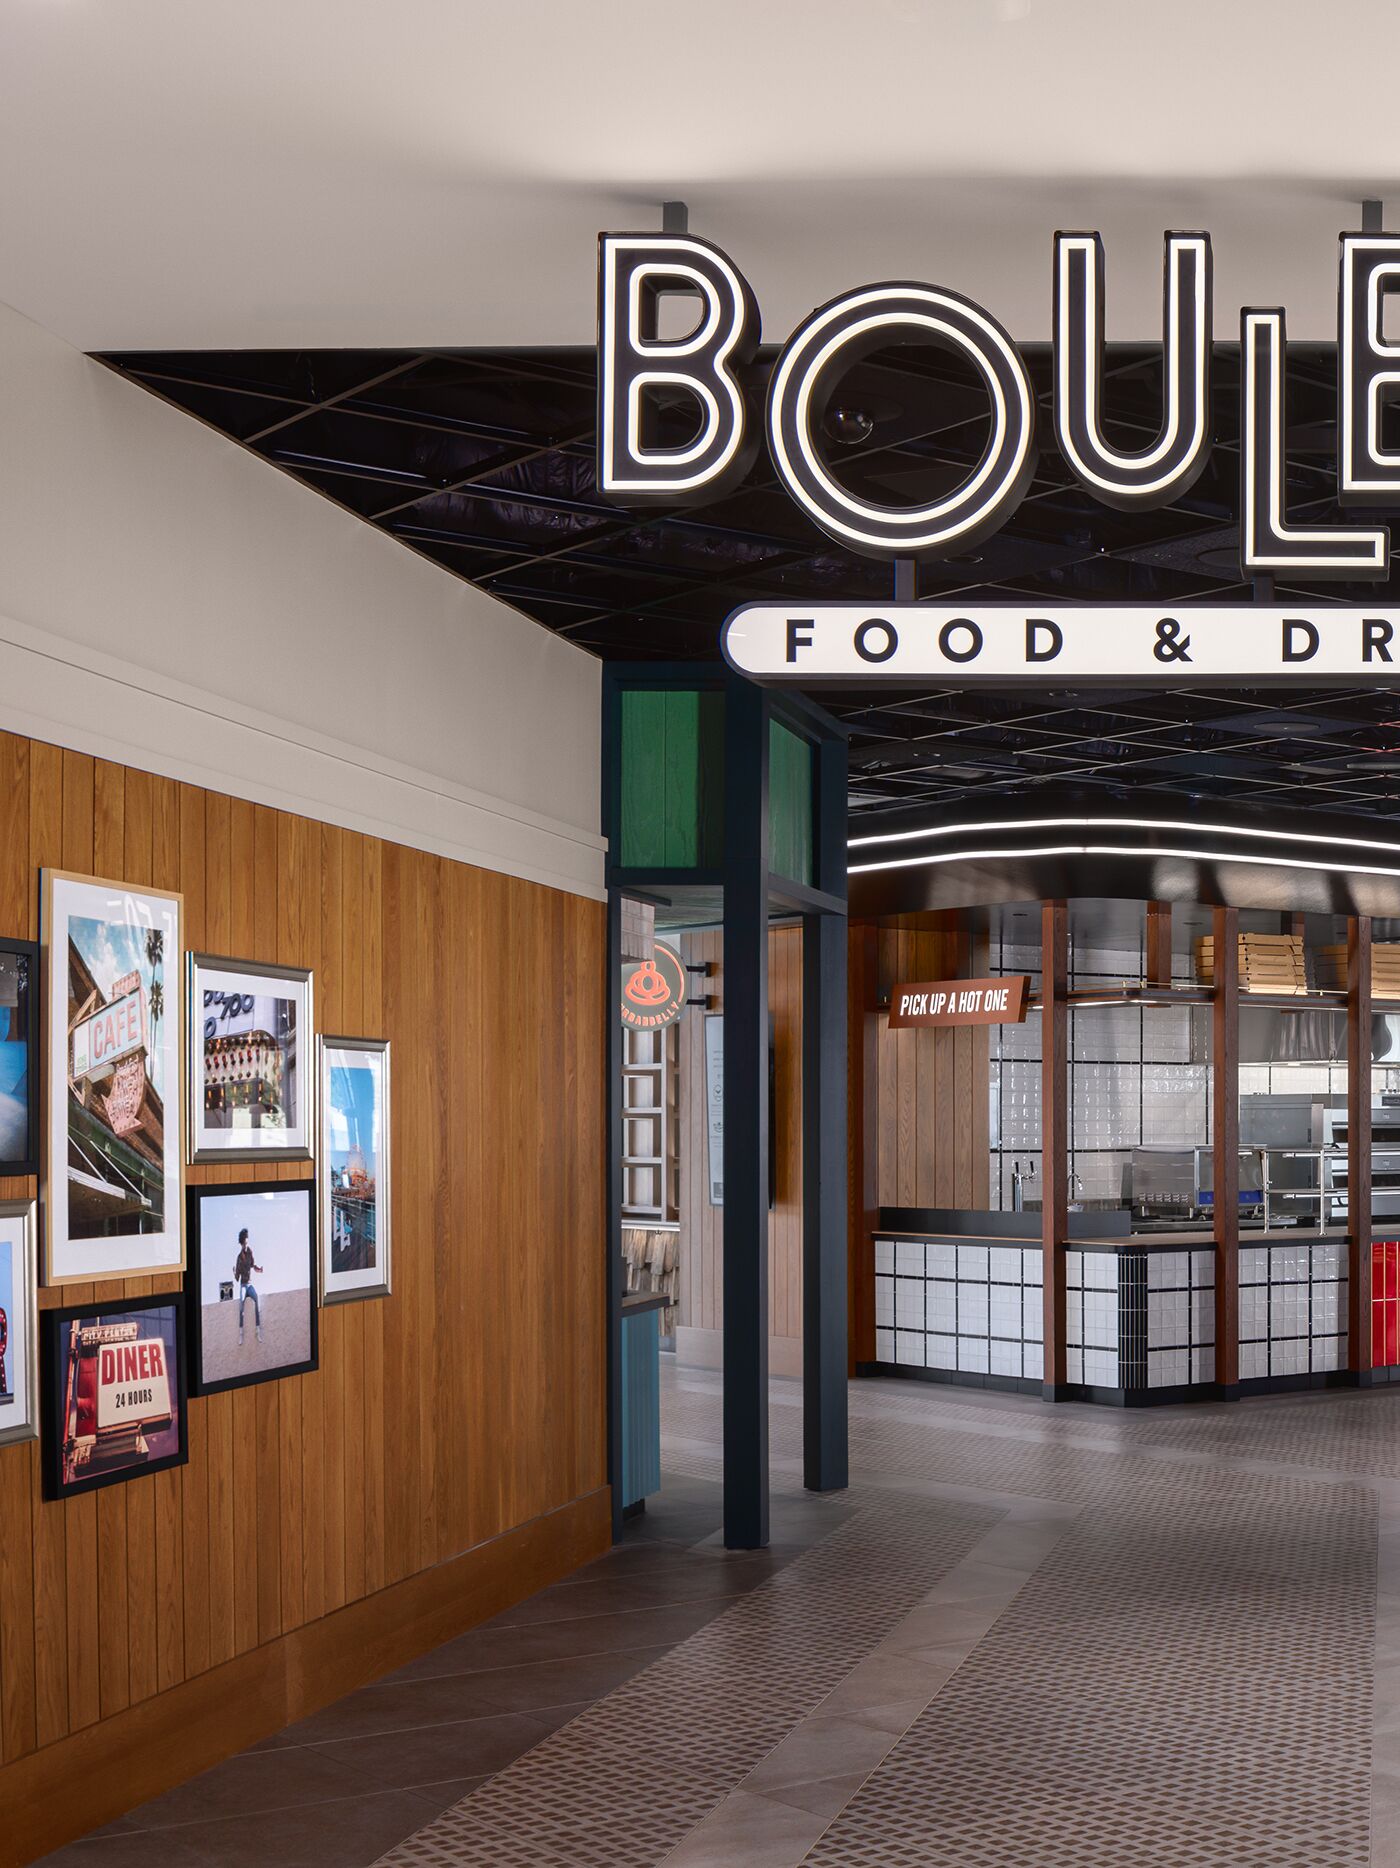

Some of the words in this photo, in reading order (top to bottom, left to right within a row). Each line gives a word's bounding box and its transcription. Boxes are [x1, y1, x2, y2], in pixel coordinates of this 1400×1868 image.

[785, 618, 1064, 664] FOOD
[1153, 618, 1193, 664] &
[900, 993, 929, 1016] PICK
[930, 992, 946, 1015] UP
[947, 992, 955, 1014] A
[958, 990, 983, 1013] HOT
[984, 988, 1009, 1012] ONE
[94, 1000, 138, 1059] CAFE
[101, 1344, 163, 1385] DINER
[115, 1393, 126, 1409] 24
[128, 1388, 153, 1406] HOURS
